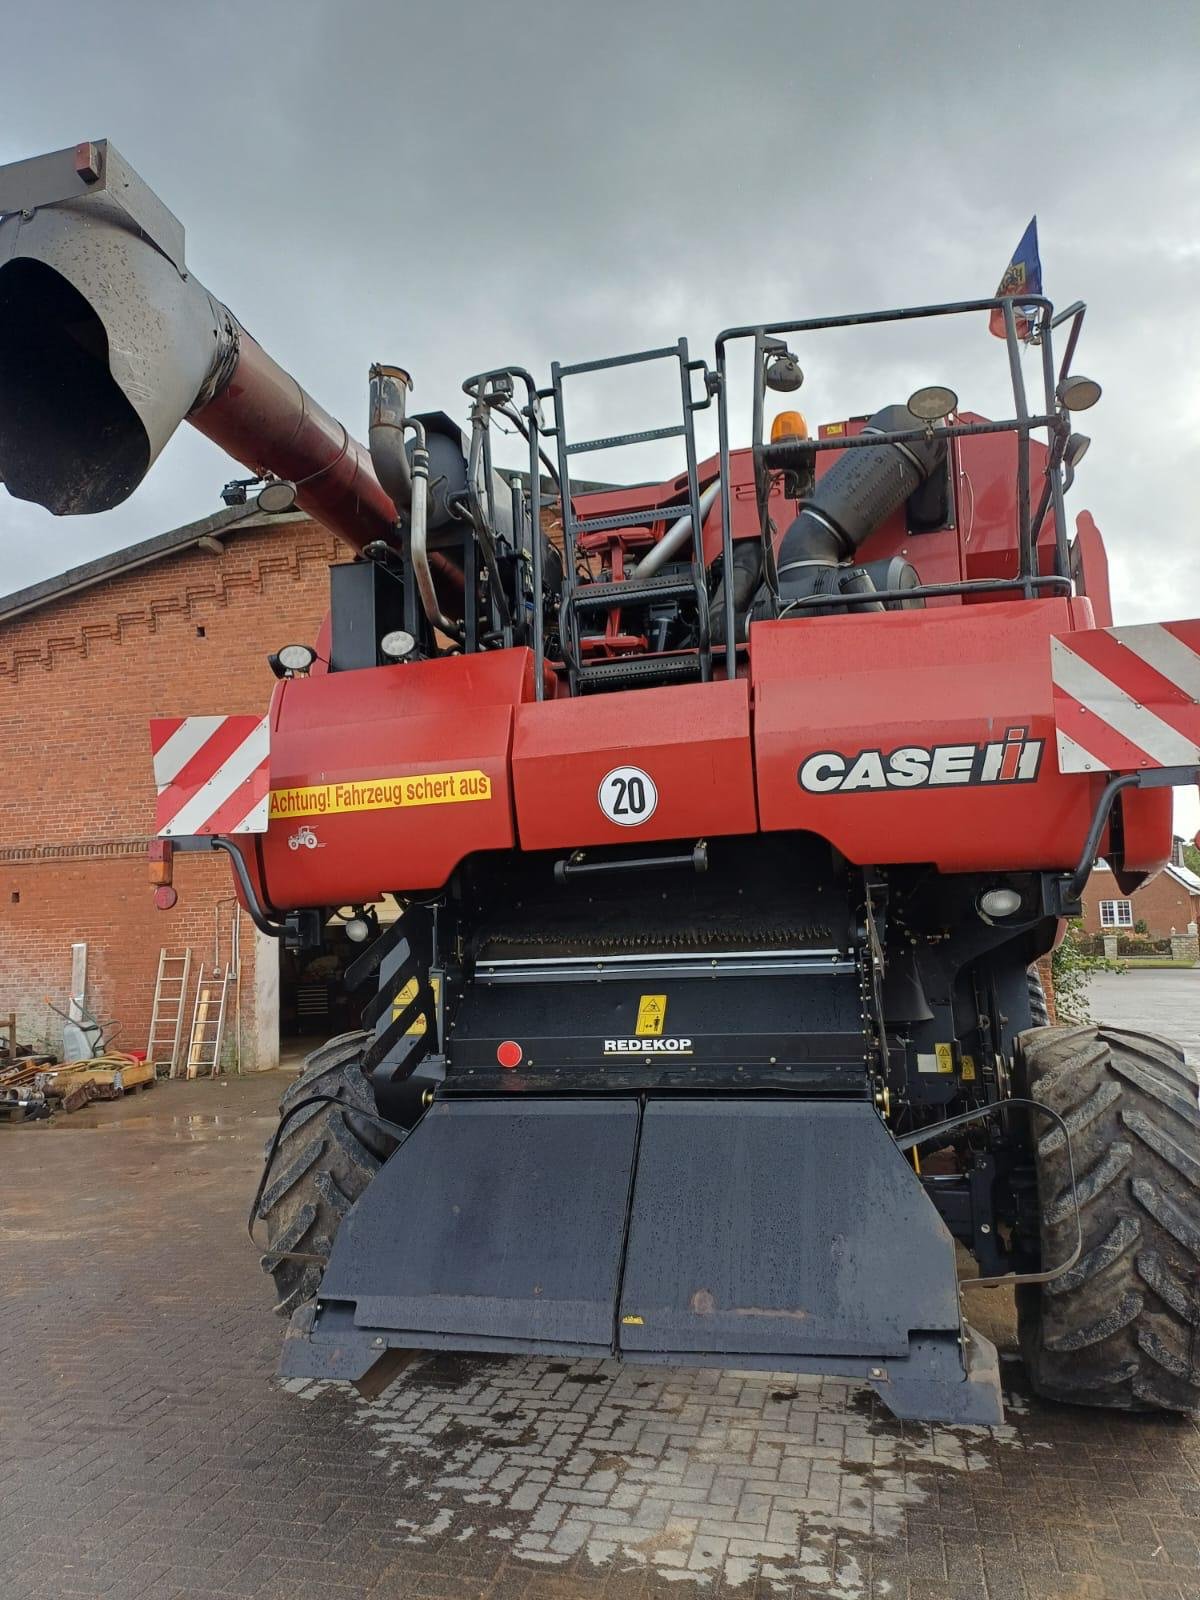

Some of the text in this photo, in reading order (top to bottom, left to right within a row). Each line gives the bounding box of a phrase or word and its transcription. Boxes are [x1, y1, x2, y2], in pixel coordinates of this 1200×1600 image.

[800, 745, 976, 792] CASE
[270, 776, 488, 813] Achtung! Fahrzeug schert aus
[611, 777, 646, 815] 20
[604, 1038, 692, 1051] REDEKOP
